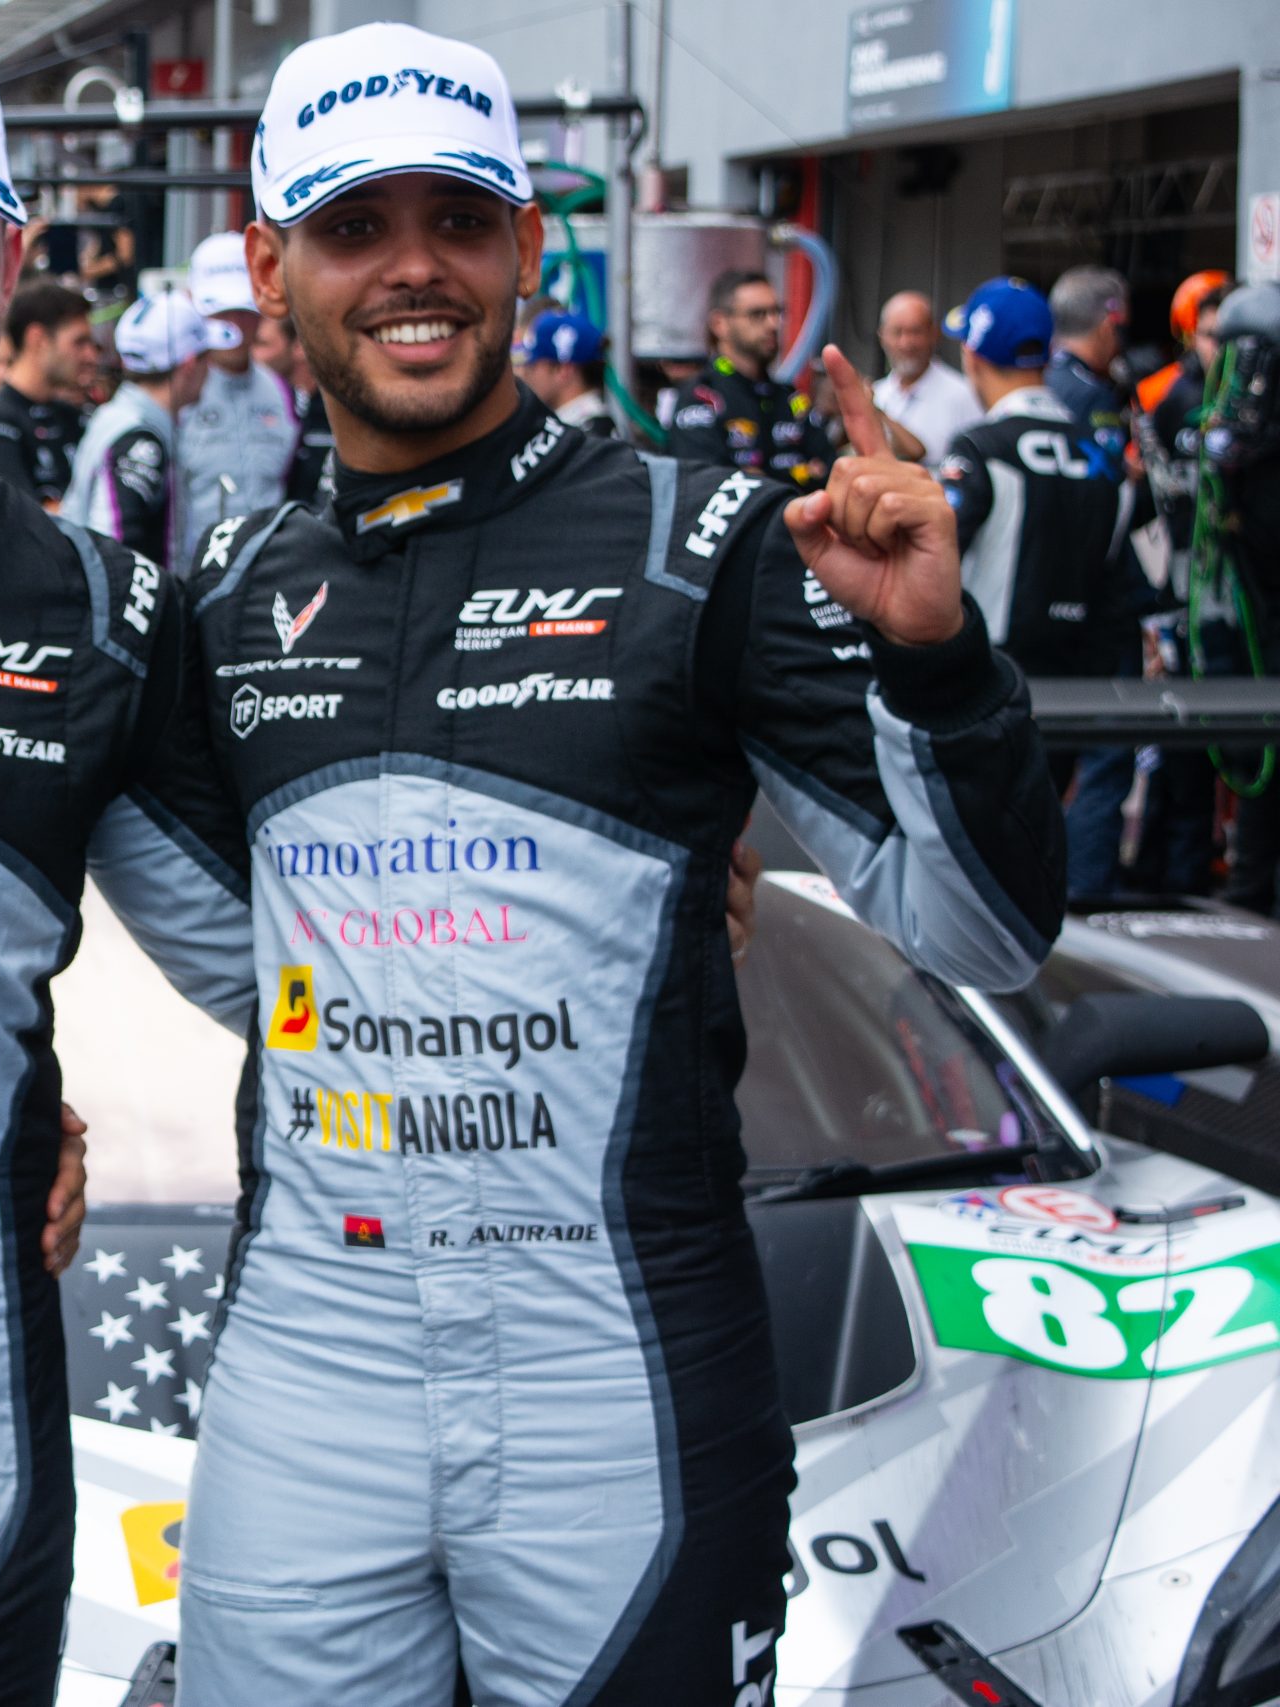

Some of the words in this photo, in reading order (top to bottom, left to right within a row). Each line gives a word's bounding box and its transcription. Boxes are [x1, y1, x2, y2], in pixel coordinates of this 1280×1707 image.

[297, 68, 493, 129] GOODYEAR
[1017, 430, 1115, 480] CLX
[685, 470, 762, 558] HRX
[458, 588, 623, 623] ELMS
[454, 638, 502, 651] SERIES
[455, 625, 527, 640] EUROPEAN
[535, 622, 552, 635] LE
[555, 621, 595, 634] MANS
[14, 674, 50, 692] MANS
[216, 658, 362, 677] CORVETTE
[235, 699, 254, 723] TF
[261, 694, 343, 721] SPORT
[437, 673, 615, 710] GOODYEAR
[339, 905, 528, 948] GLOBAL
[323, 998, 579, 1070] Sonangol
[285, 1086, 557, 1156] #VISITANGOLA
[428, 1229, 456, 1248] R.
[468, 1223, 599, 1247] ANDRADE
[971, 1258, 1280, 1372] 82
